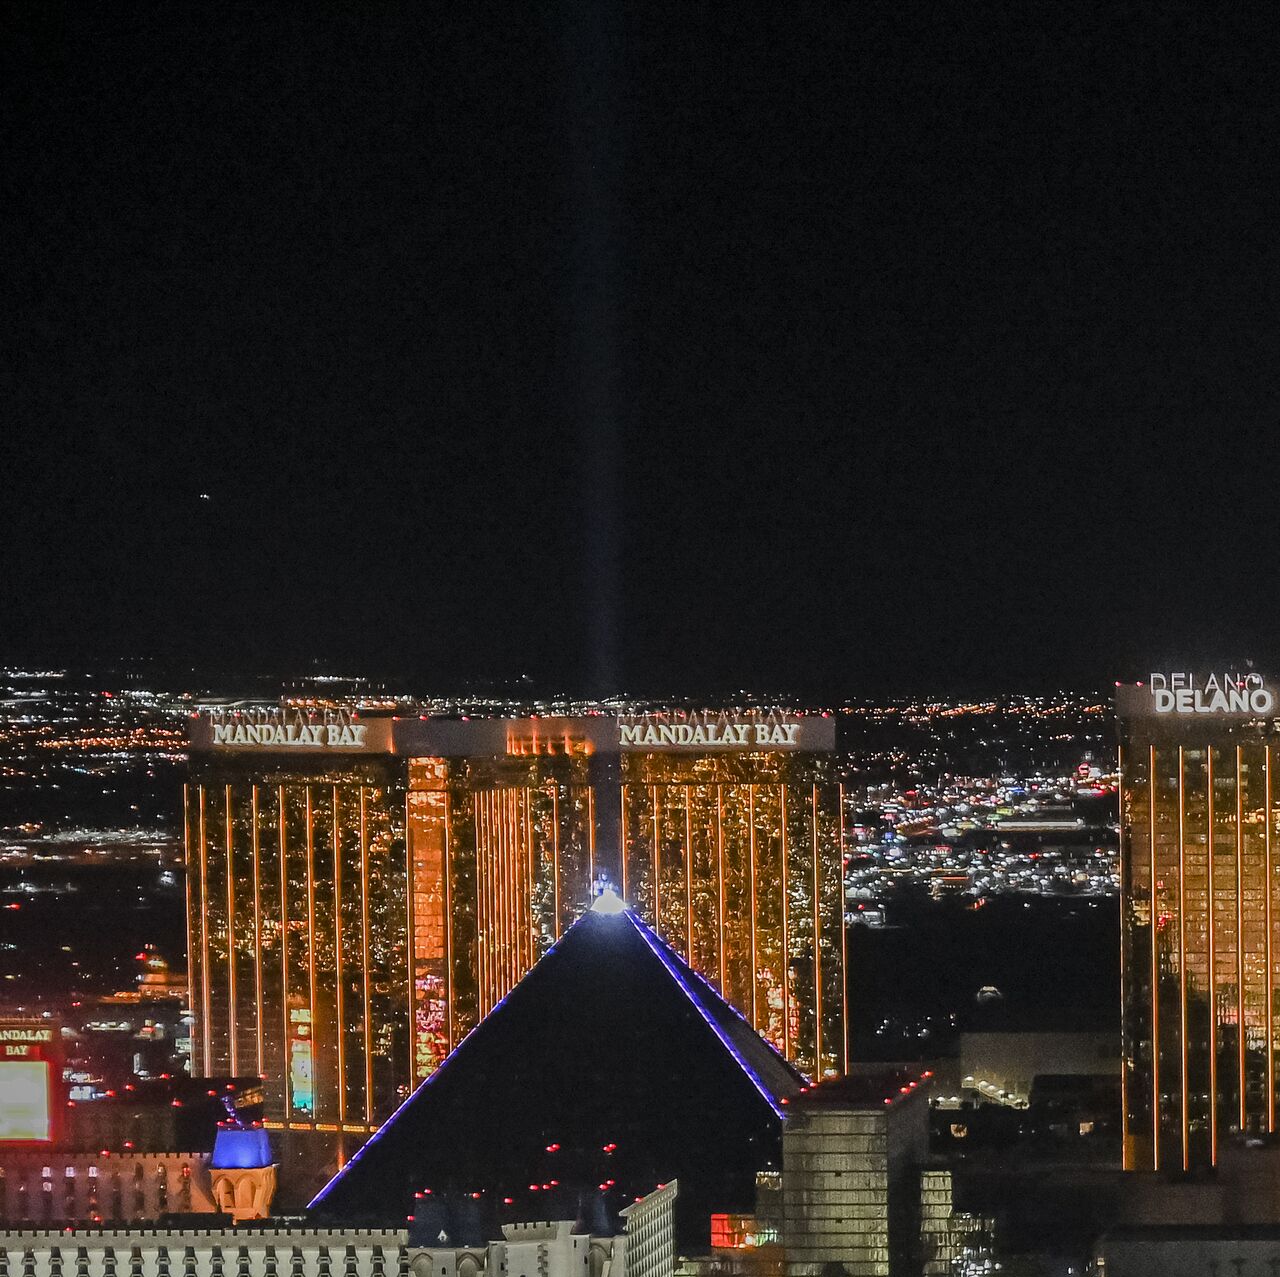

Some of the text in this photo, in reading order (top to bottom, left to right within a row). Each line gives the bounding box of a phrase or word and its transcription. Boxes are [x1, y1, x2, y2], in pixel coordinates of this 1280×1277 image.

[1155, 689, 1272, 712] DELANO
[213, 724, 366, 747] MANDALAY BAY
[619, 724, 800, 745] MANDALAY BAY
[6, 1045, 28, 1055] BAY
